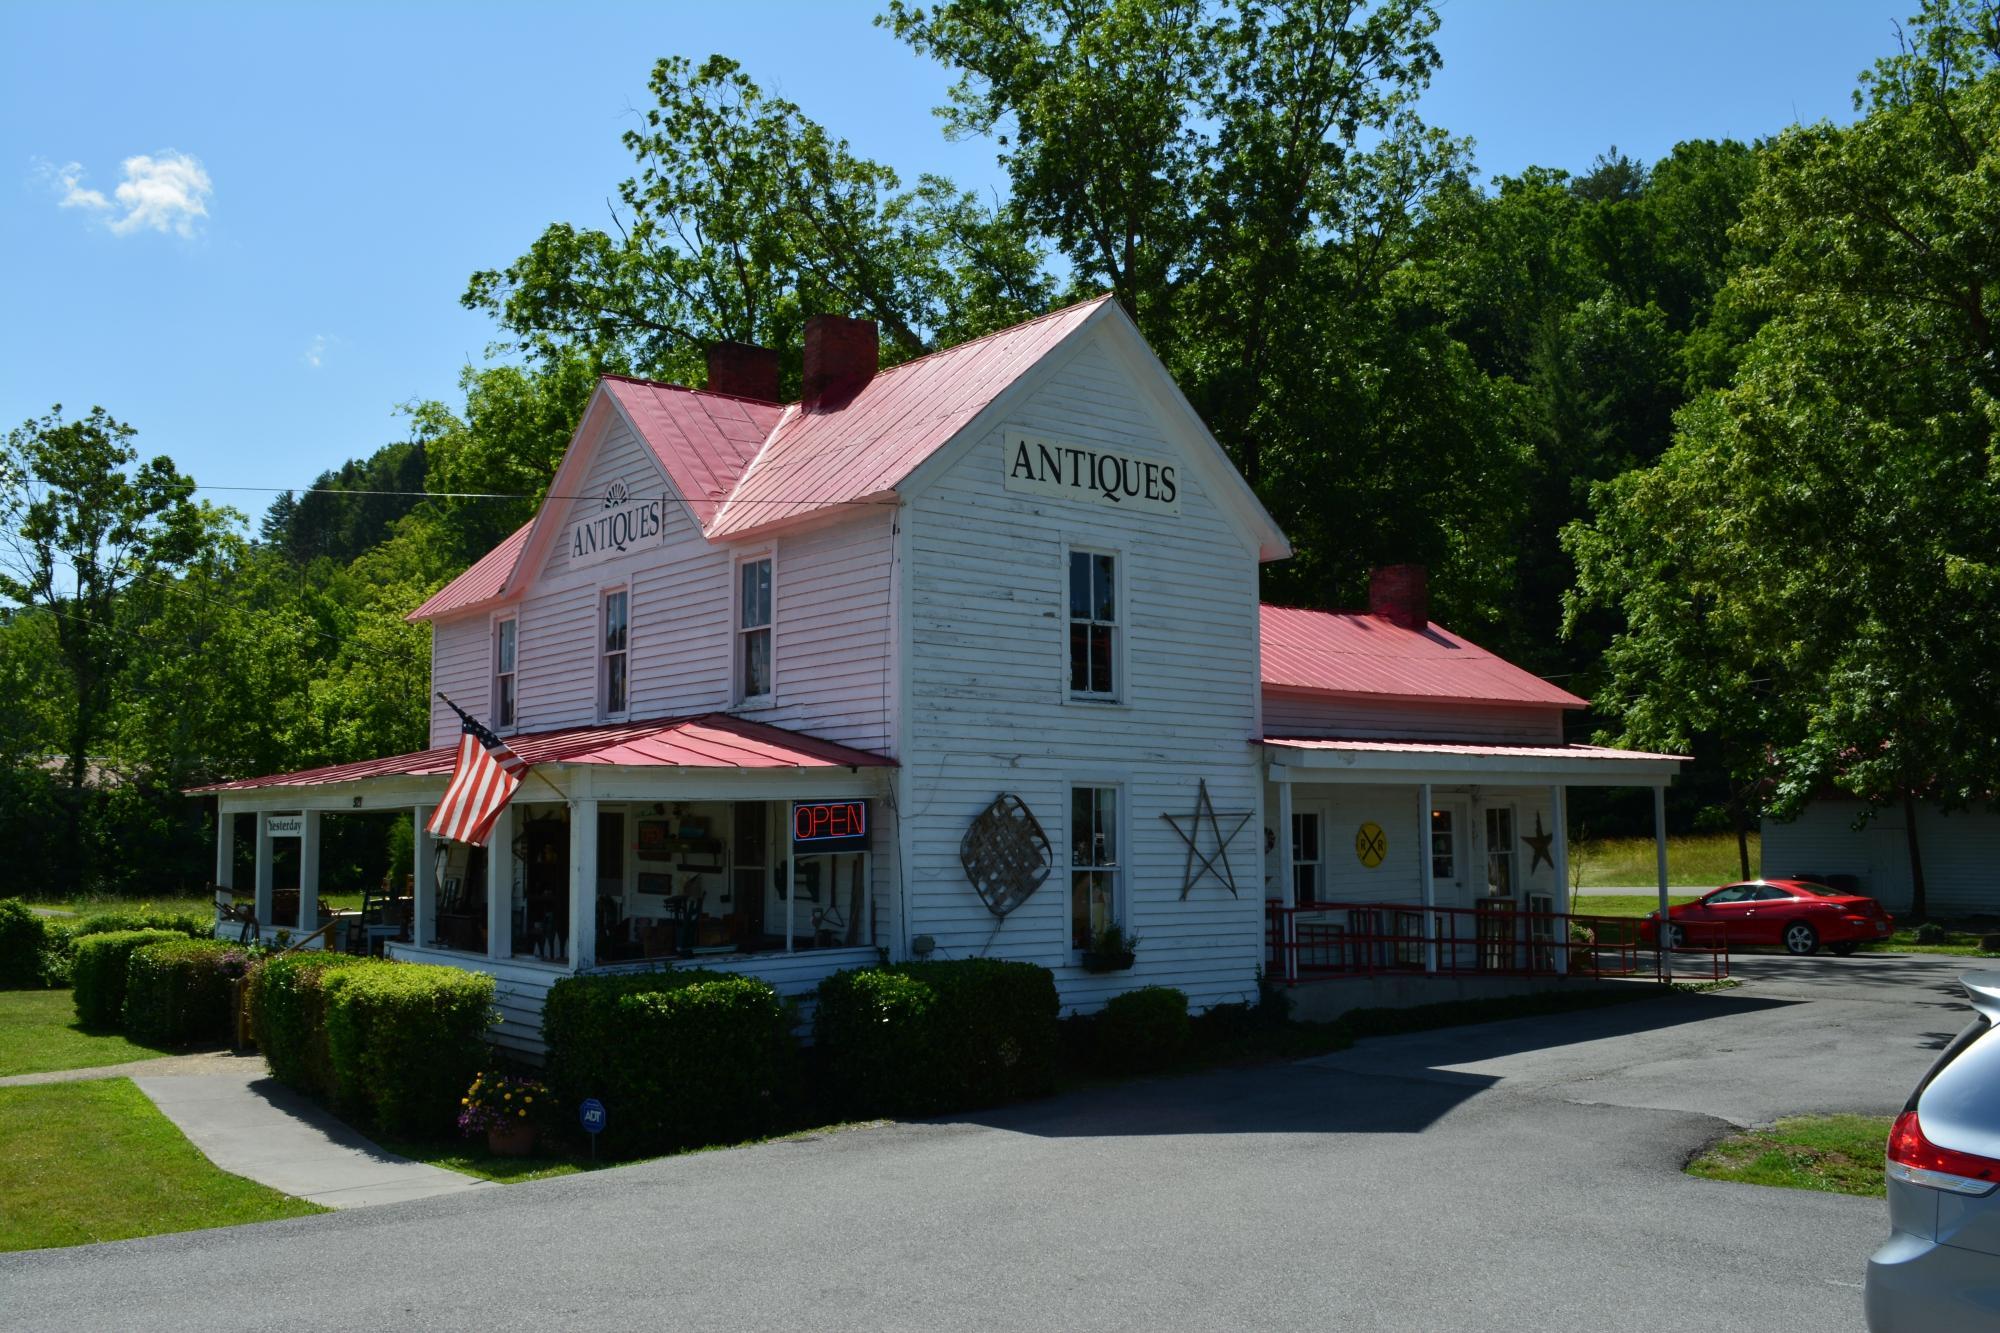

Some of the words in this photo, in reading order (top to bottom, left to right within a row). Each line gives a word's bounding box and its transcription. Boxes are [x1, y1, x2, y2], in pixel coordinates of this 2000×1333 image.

[1010, 440, 1177, 503] ANTIQUES
[572, 501, 660, 558] ANTIQUES
[796, 804, 864, 838] OPEN
[584, 1109, 601, 1123] ADT
